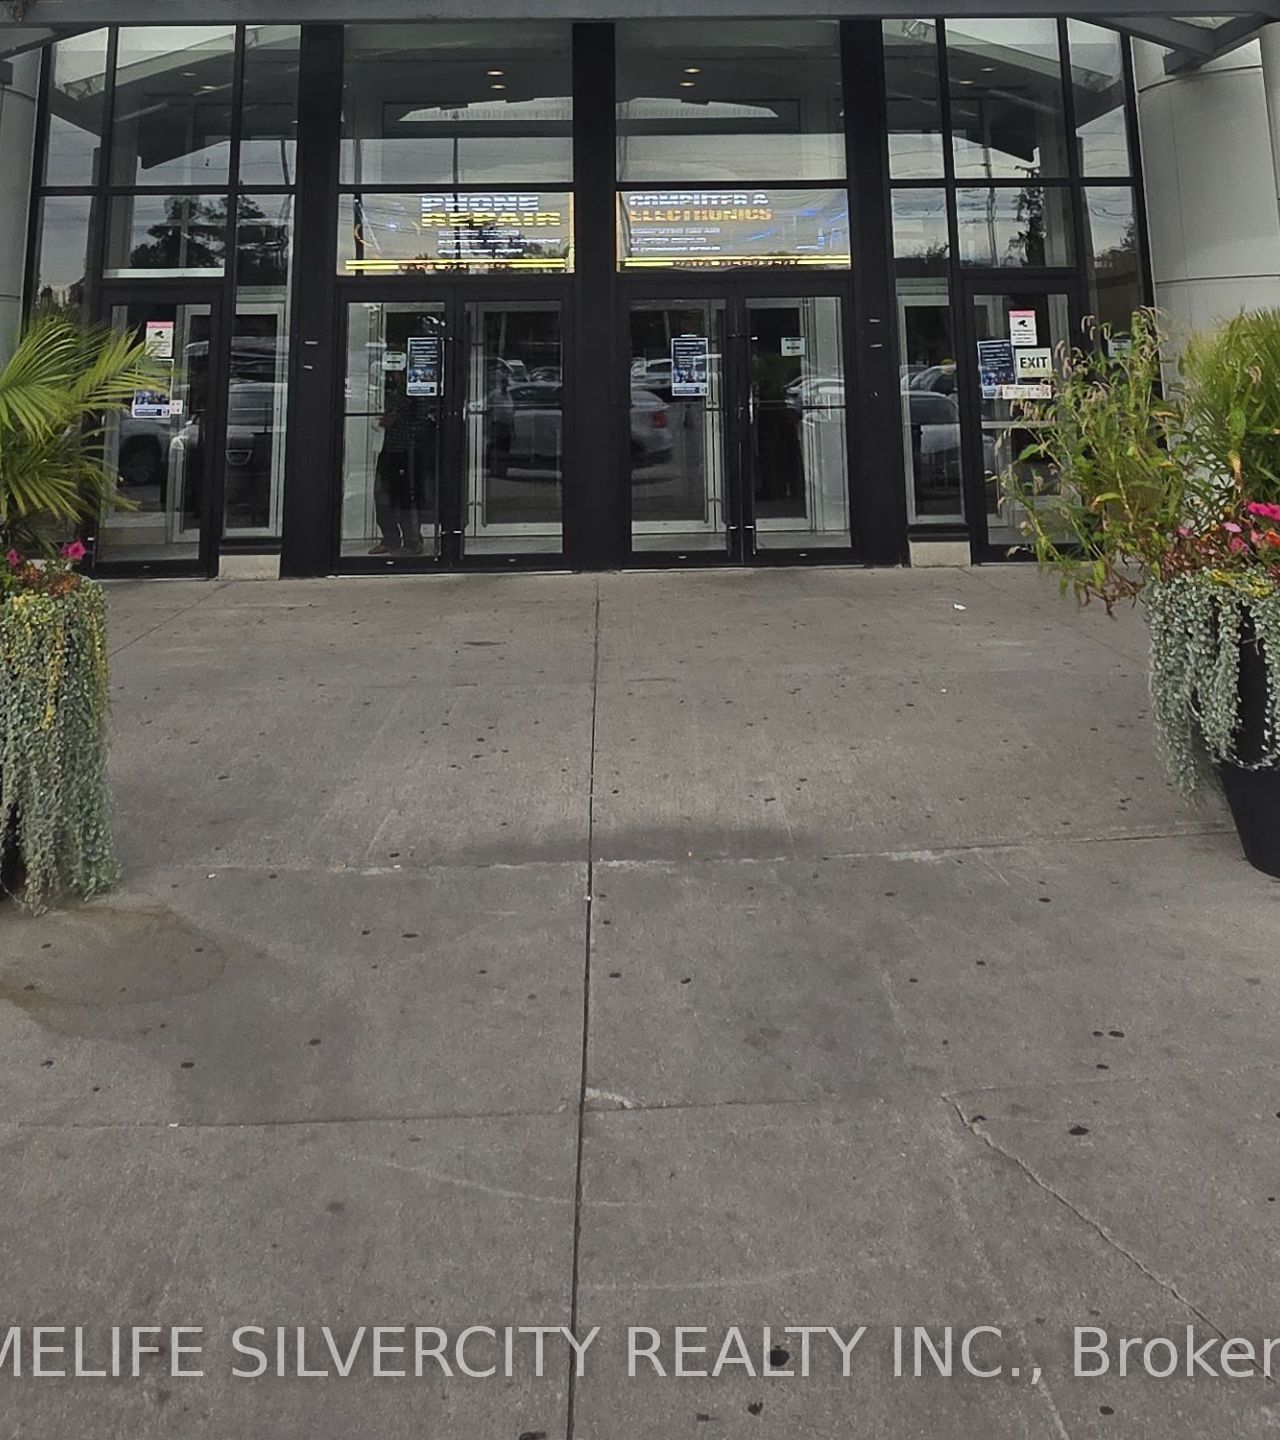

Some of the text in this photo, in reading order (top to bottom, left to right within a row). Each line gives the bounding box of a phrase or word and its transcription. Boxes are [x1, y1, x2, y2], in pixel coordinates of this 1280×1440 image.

[422, 196, 539, 212] PHONE
[422, 212, 561, 227] REPAIR
[629, 208, 773, 223] ELECTRONICS
[1019, 356, 1048, 369] EXIT
